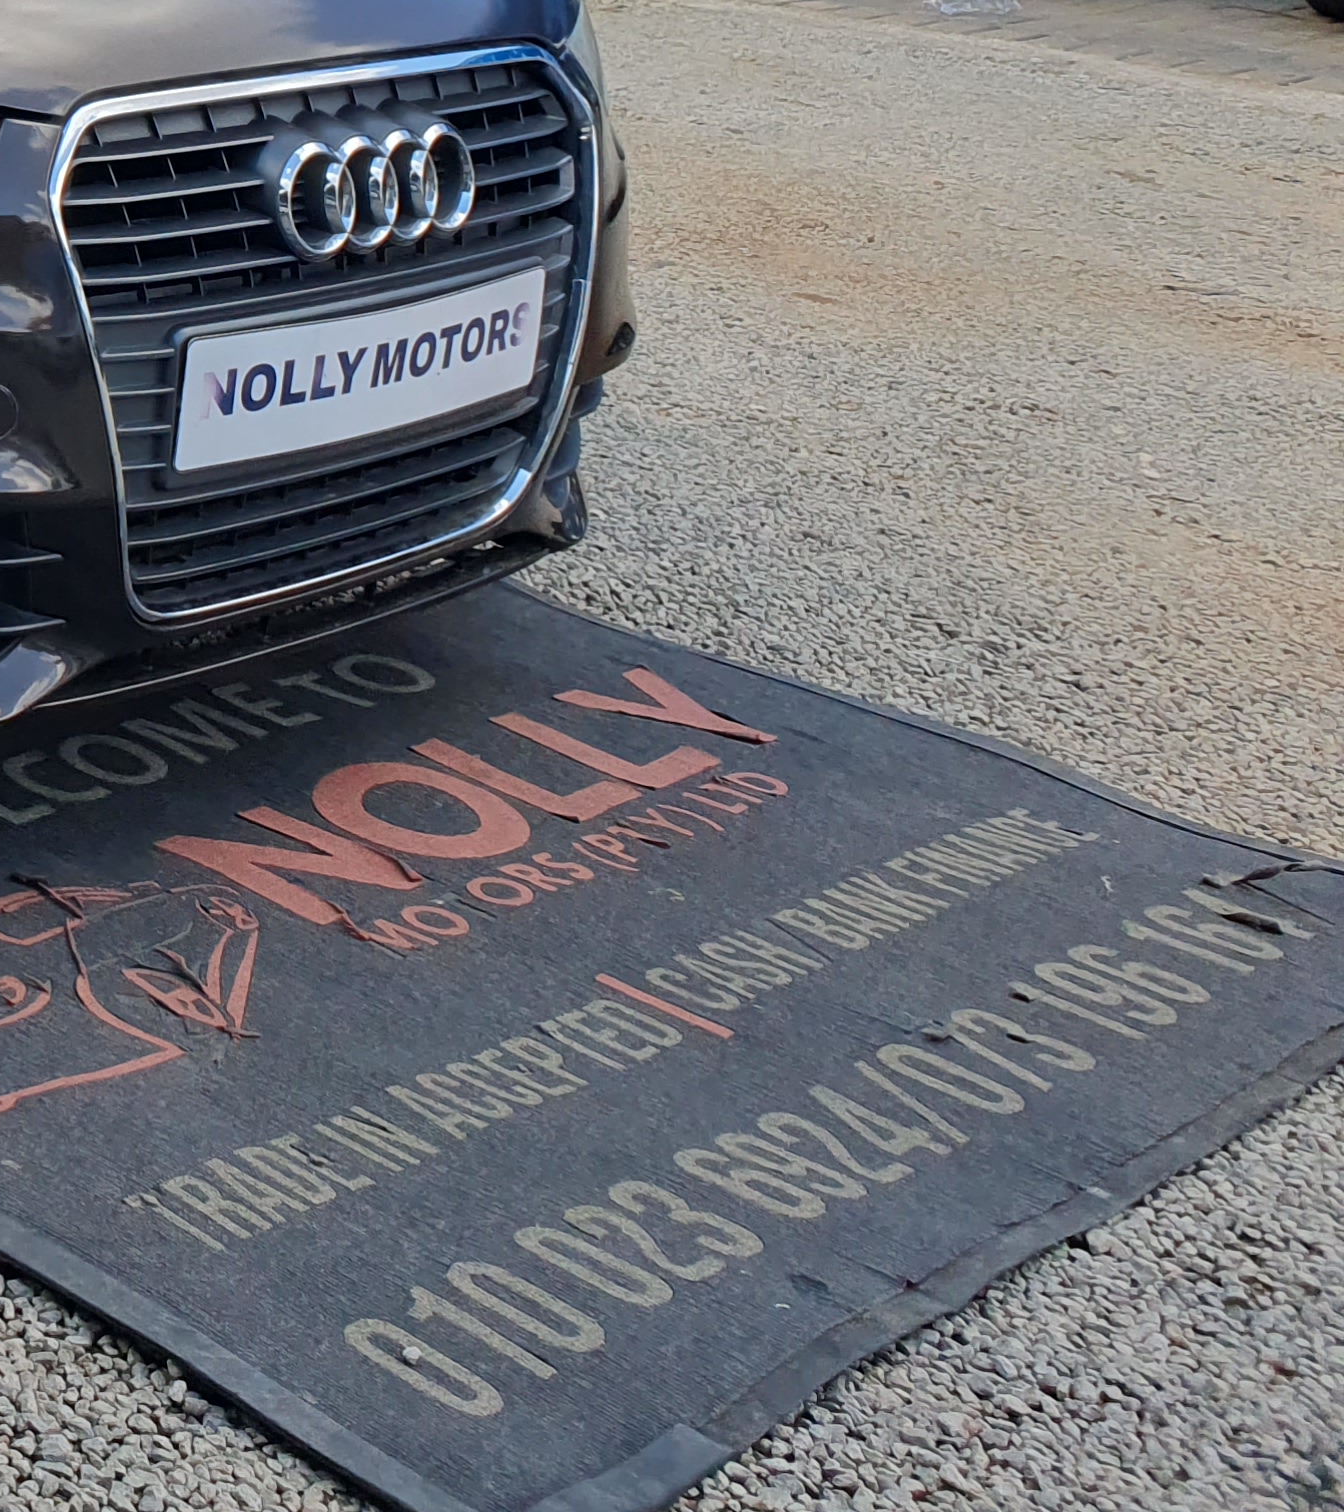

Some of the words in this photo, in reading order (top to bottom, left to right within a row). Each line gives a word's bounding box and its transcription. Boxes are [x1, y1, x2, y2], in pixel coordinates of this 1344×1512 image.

[200, 346, 369, 420] NOLLY
[370, 301, 531, 389] MOTORS
[275, 652, 436, 707] TO
[153, 665, 778, 925] NOLLY
[365, 851, 595, 950] MOORS
[313, 1105, 440, 1173] IN
[344, 1260, 606, 1418] 010
[514, 1179, 766, 1308] 023
[1008, 943, 1212, 1041] 196
